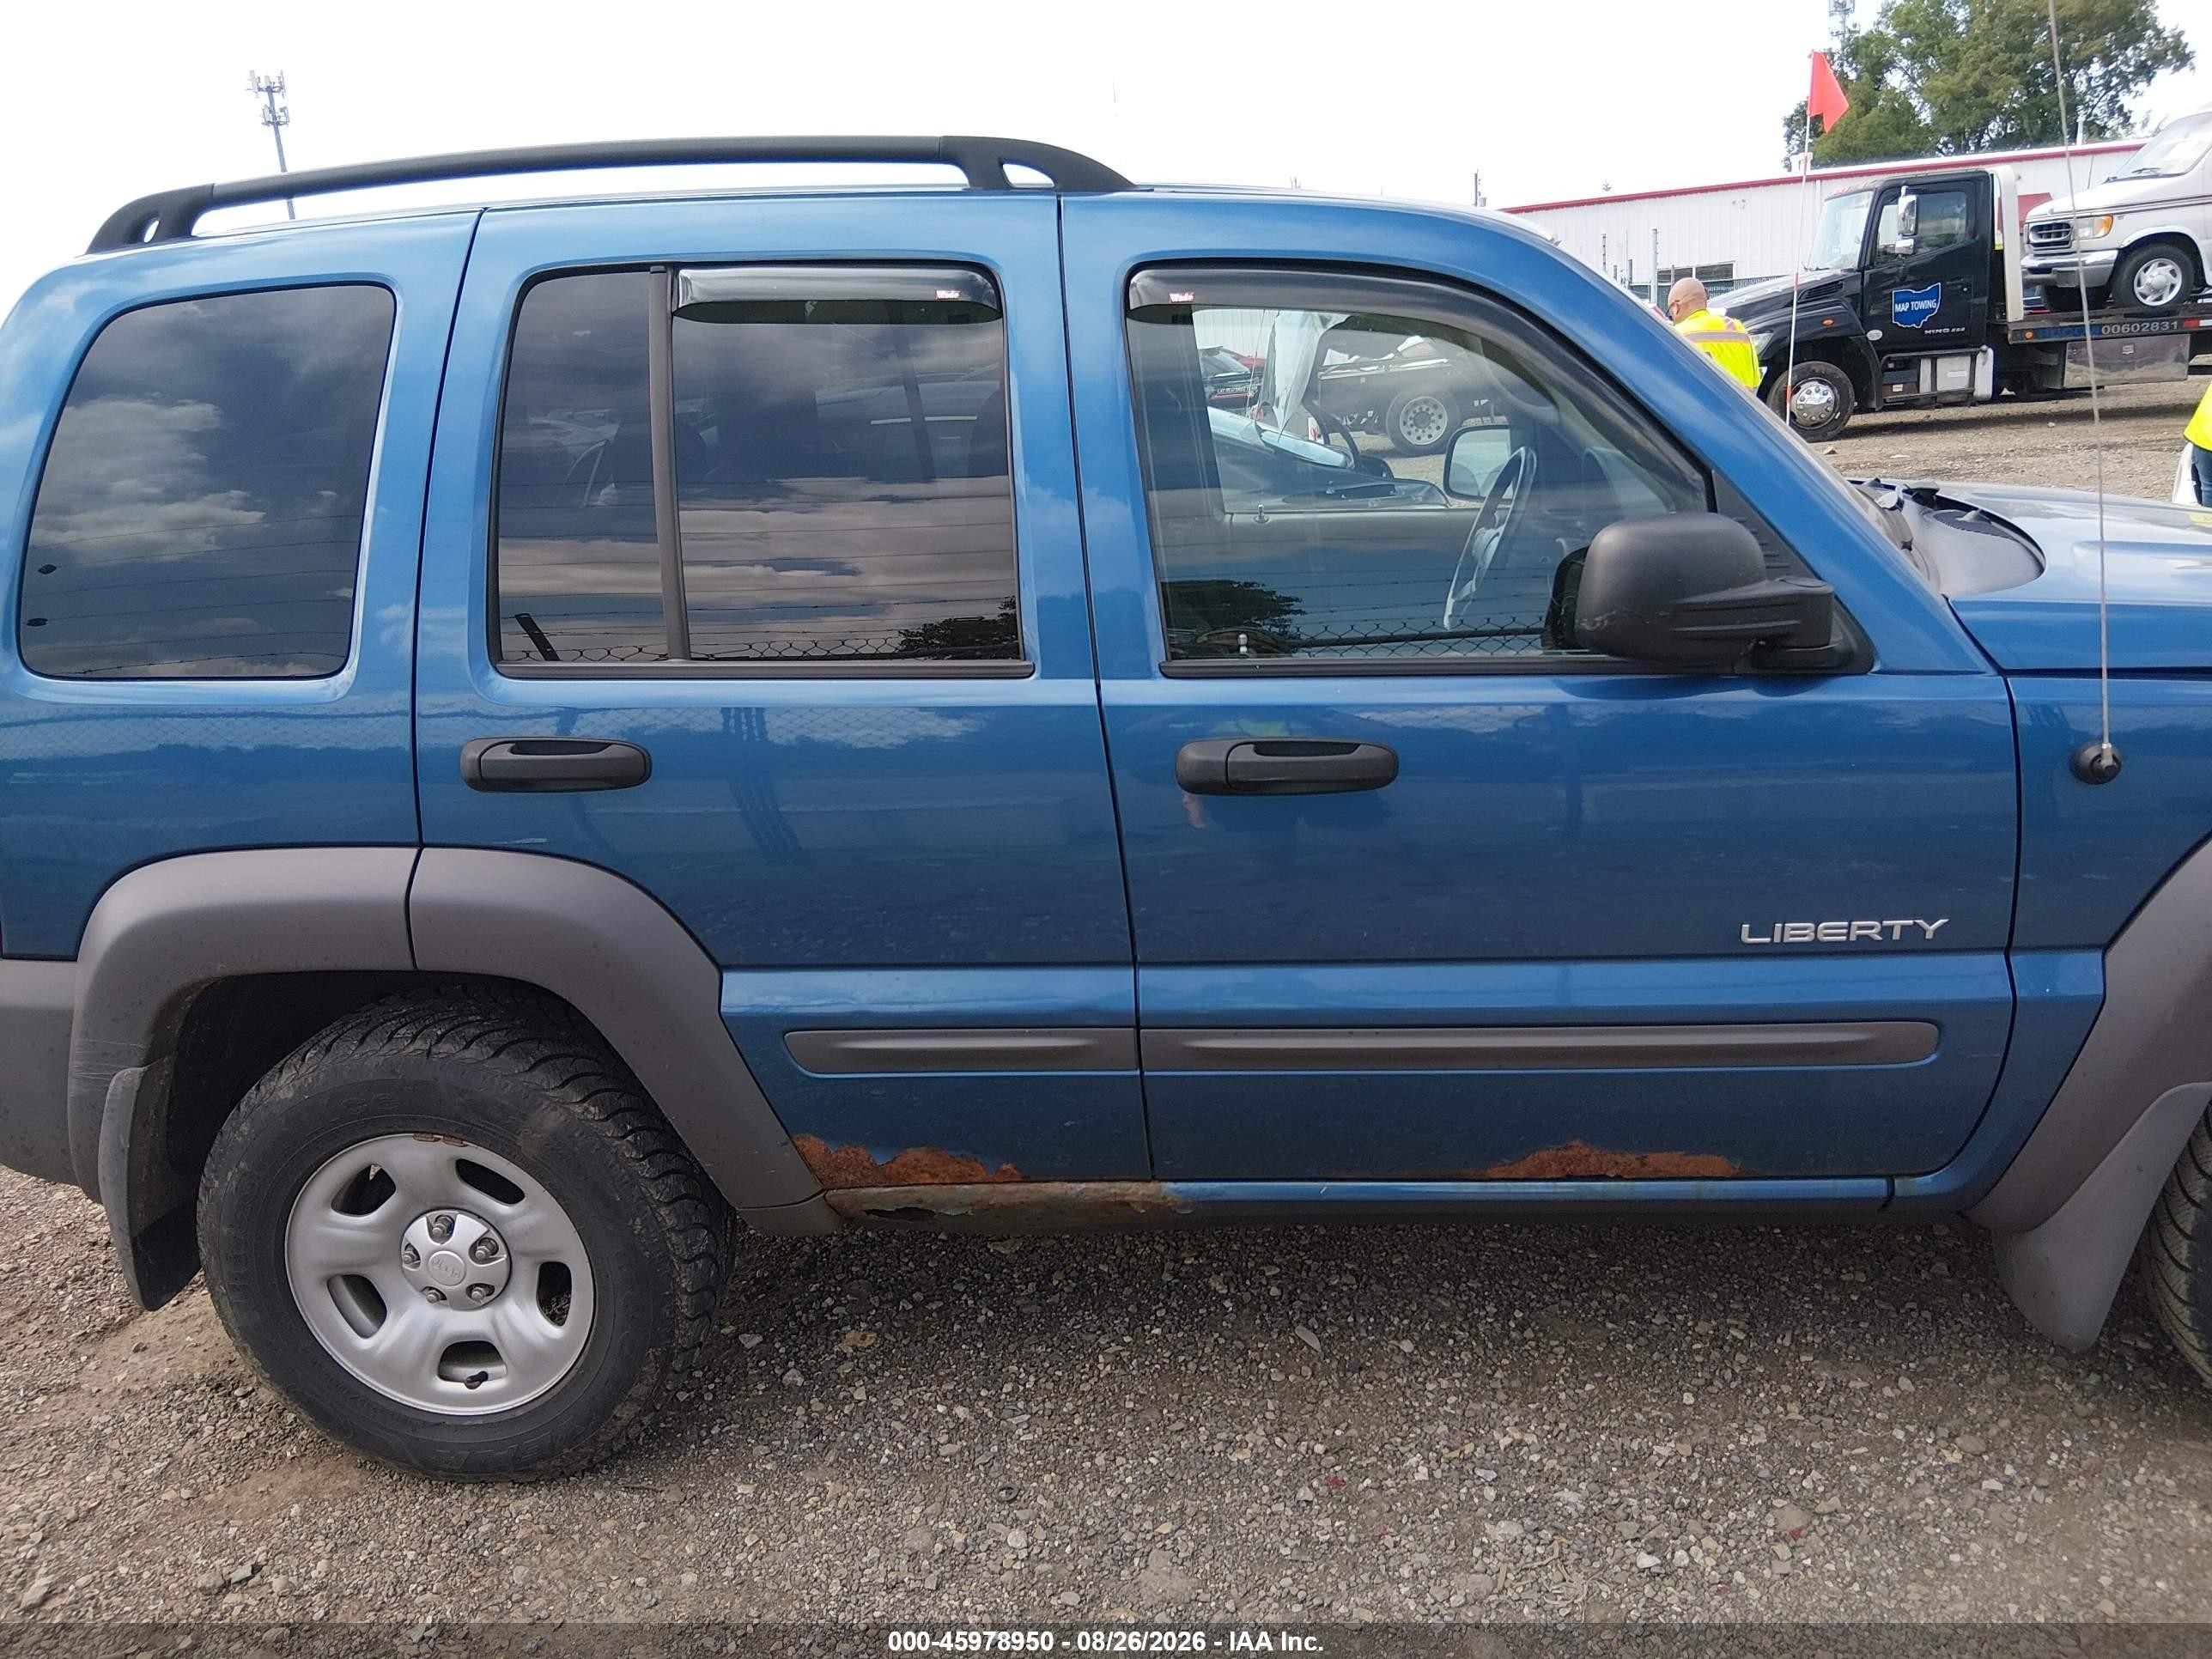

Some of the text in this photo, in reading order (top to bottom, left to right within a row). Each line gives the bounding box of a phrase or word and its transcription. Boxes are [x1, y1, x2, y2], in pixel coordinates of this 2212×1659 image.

[1894, 299, 1936, 313] MAP TOWING
[2101, 320, 2179, 334] 00602831
[1741, 918, 1950, 945] LIBERTY
